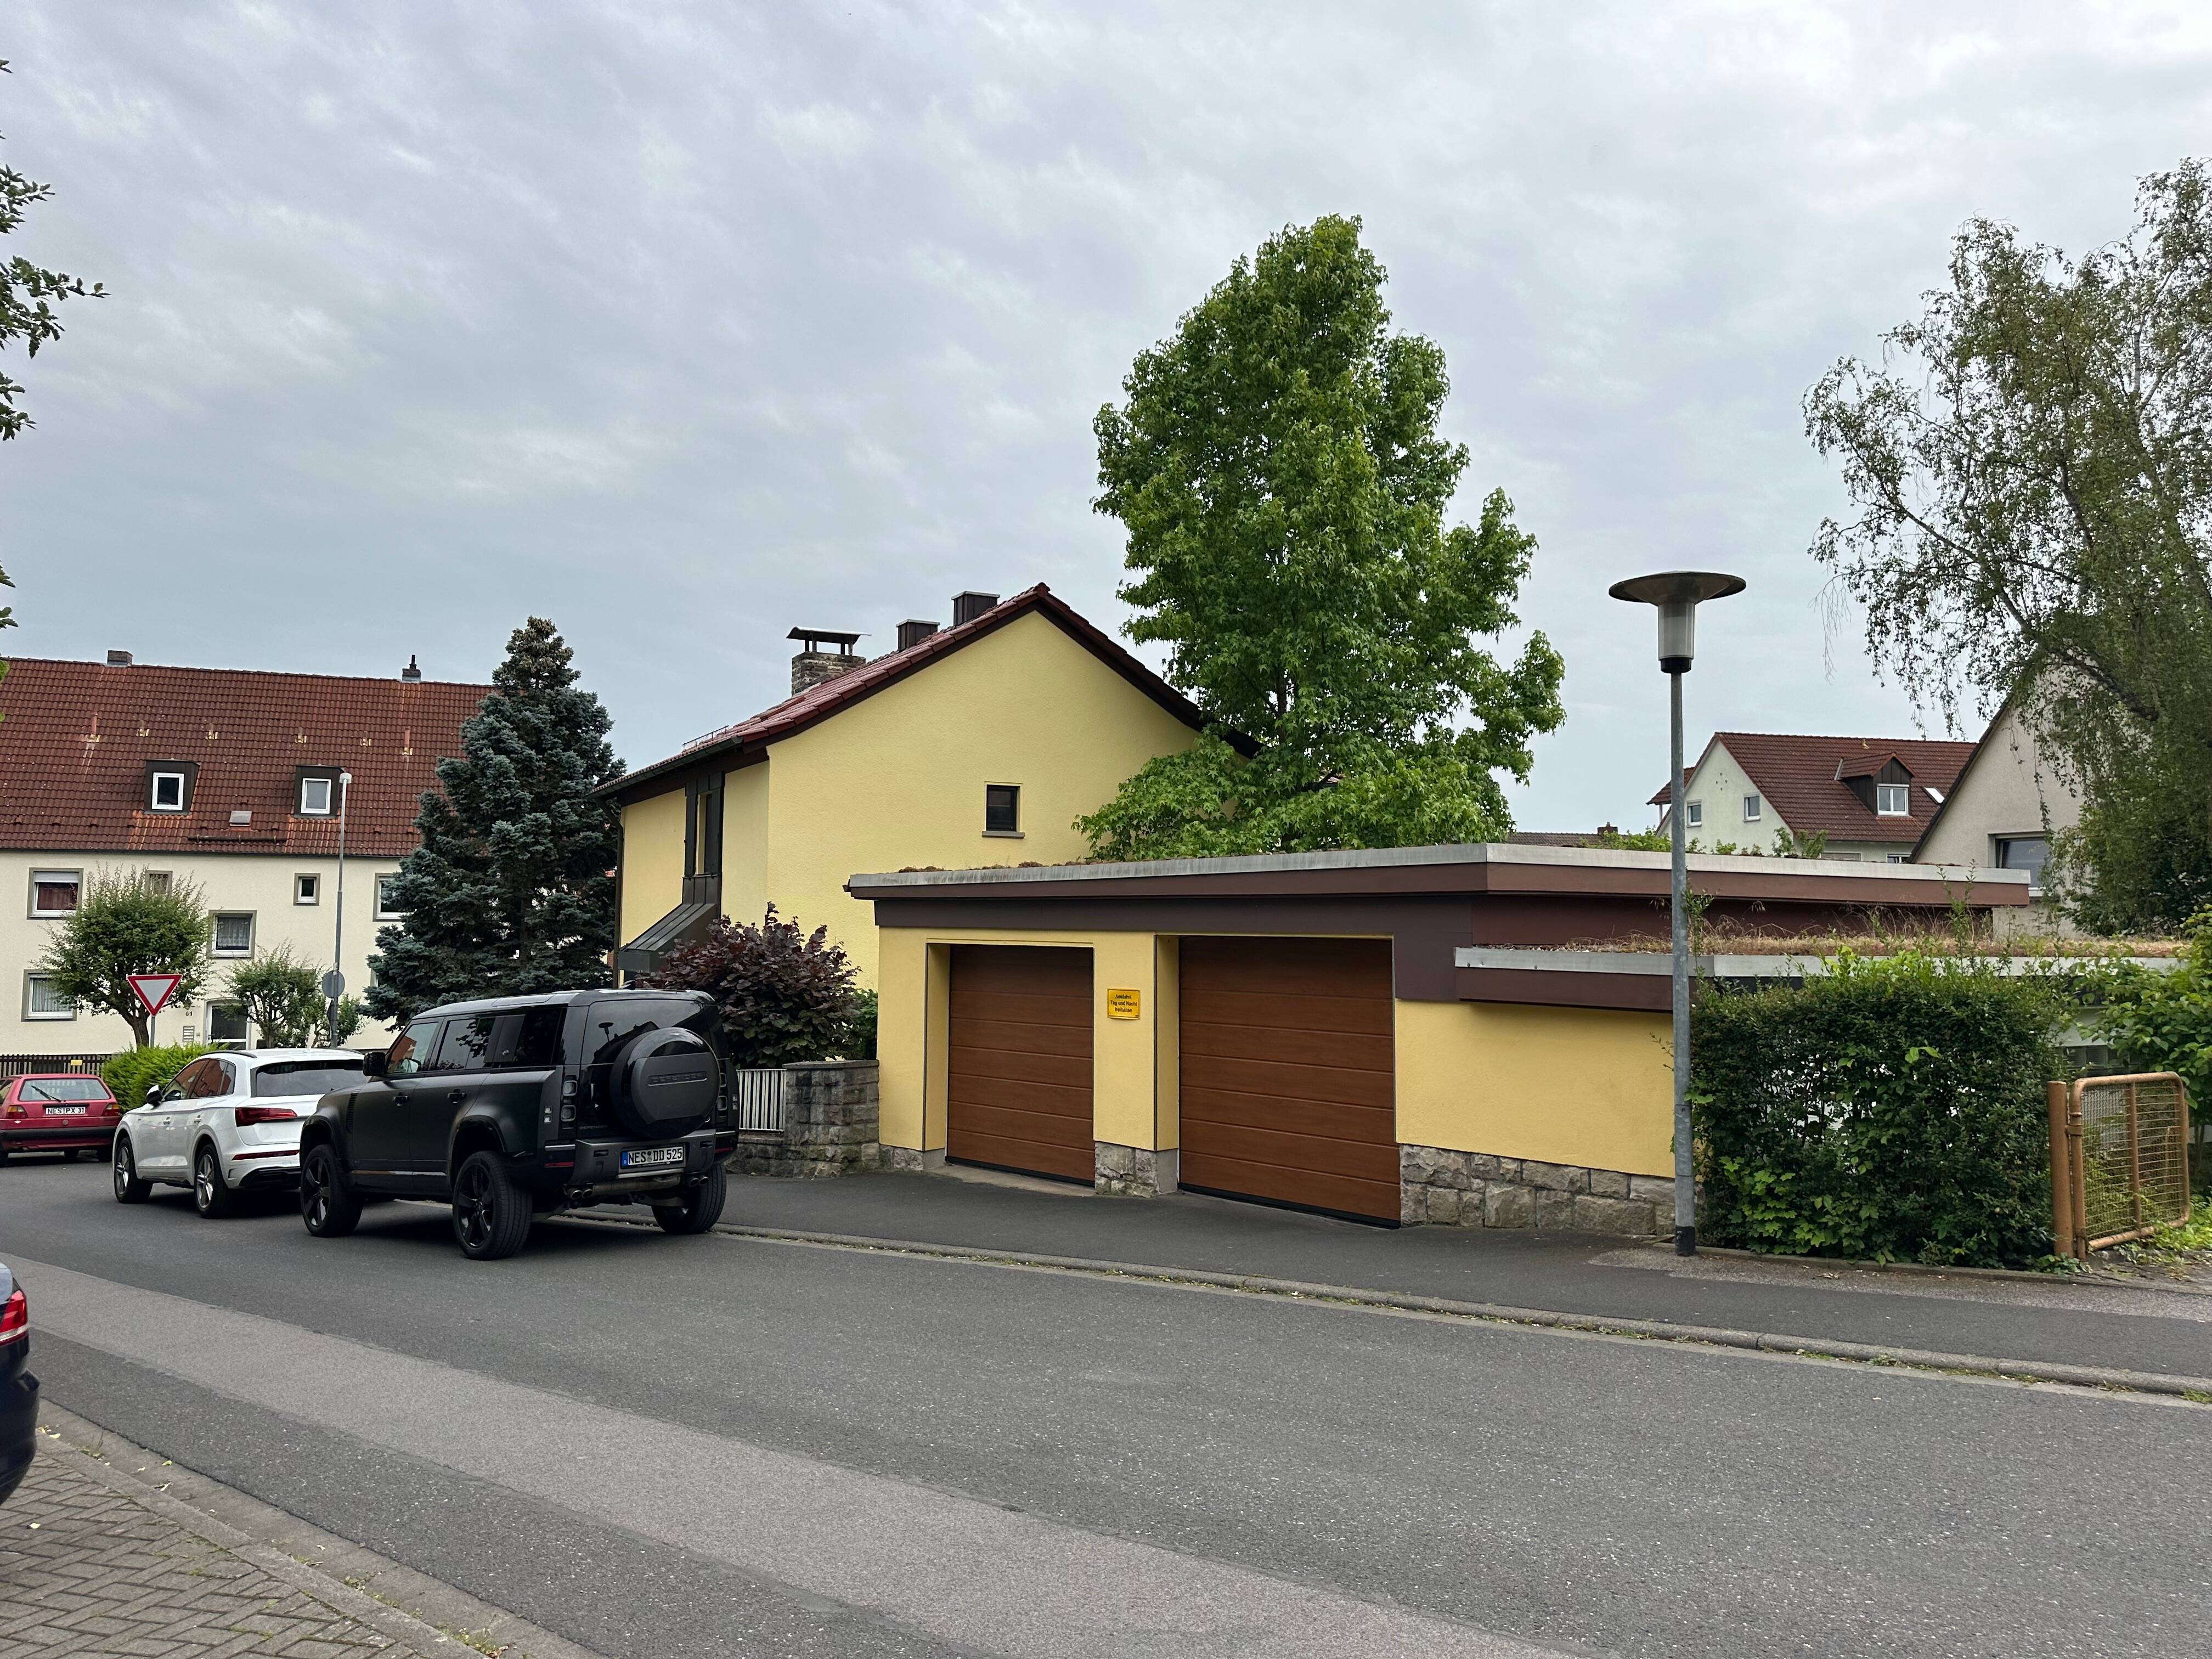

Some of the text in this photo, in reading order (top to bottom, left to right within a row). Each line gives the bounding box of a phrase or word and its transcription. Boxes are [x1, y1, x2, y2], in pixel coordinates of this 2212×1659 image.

[628, 1148, 682, 1164] NES DD 525
